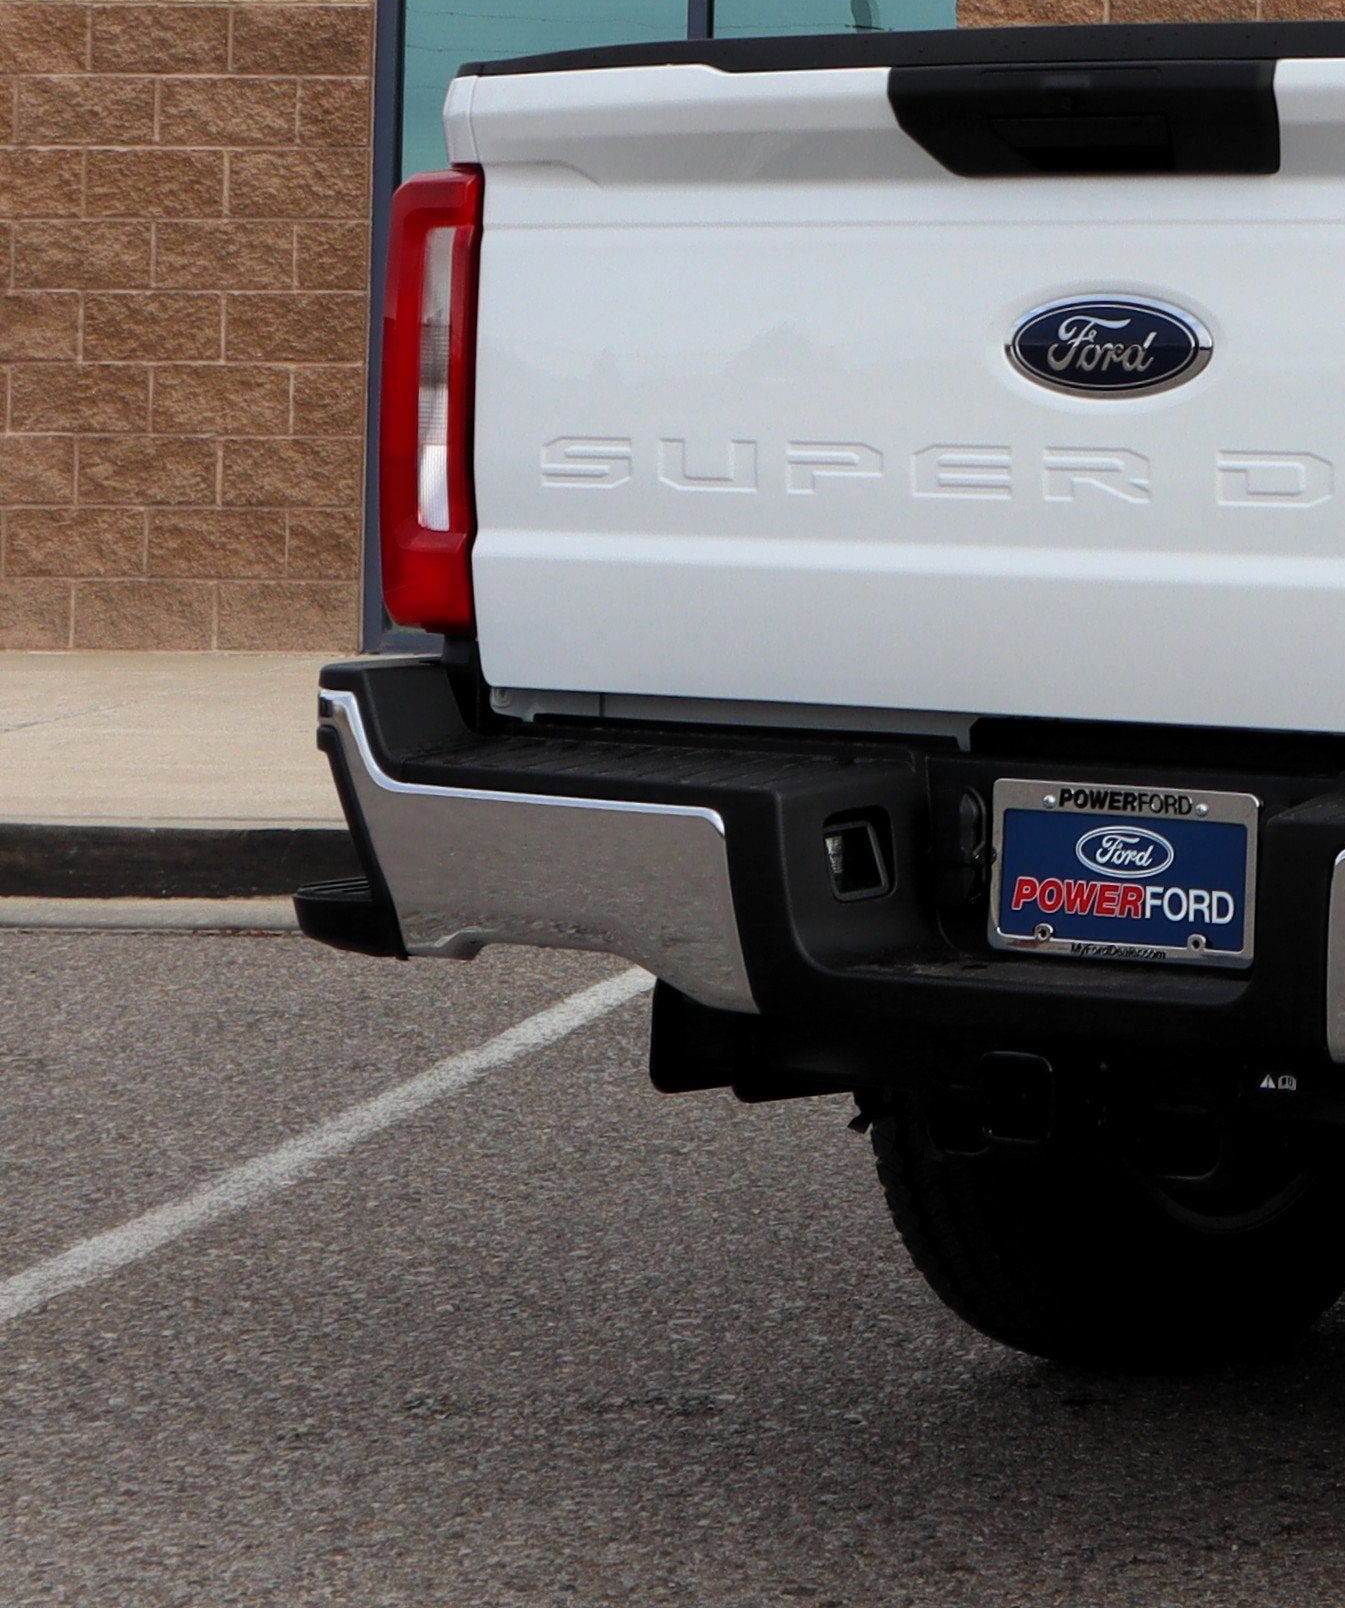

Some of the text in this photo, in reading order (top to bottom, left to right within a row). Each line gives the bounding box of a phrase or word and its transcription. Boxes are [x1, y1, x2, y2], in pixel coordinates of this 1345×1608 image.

[1047, 315, 1158, 372] Ford
[541, 435, 1151, 504] SUPER
[1058, 787, 1192, 816] POWERFORD
[1095, 834, 1154, 868] Ford
[1012, 876, 1235, 925] POWERFORD
